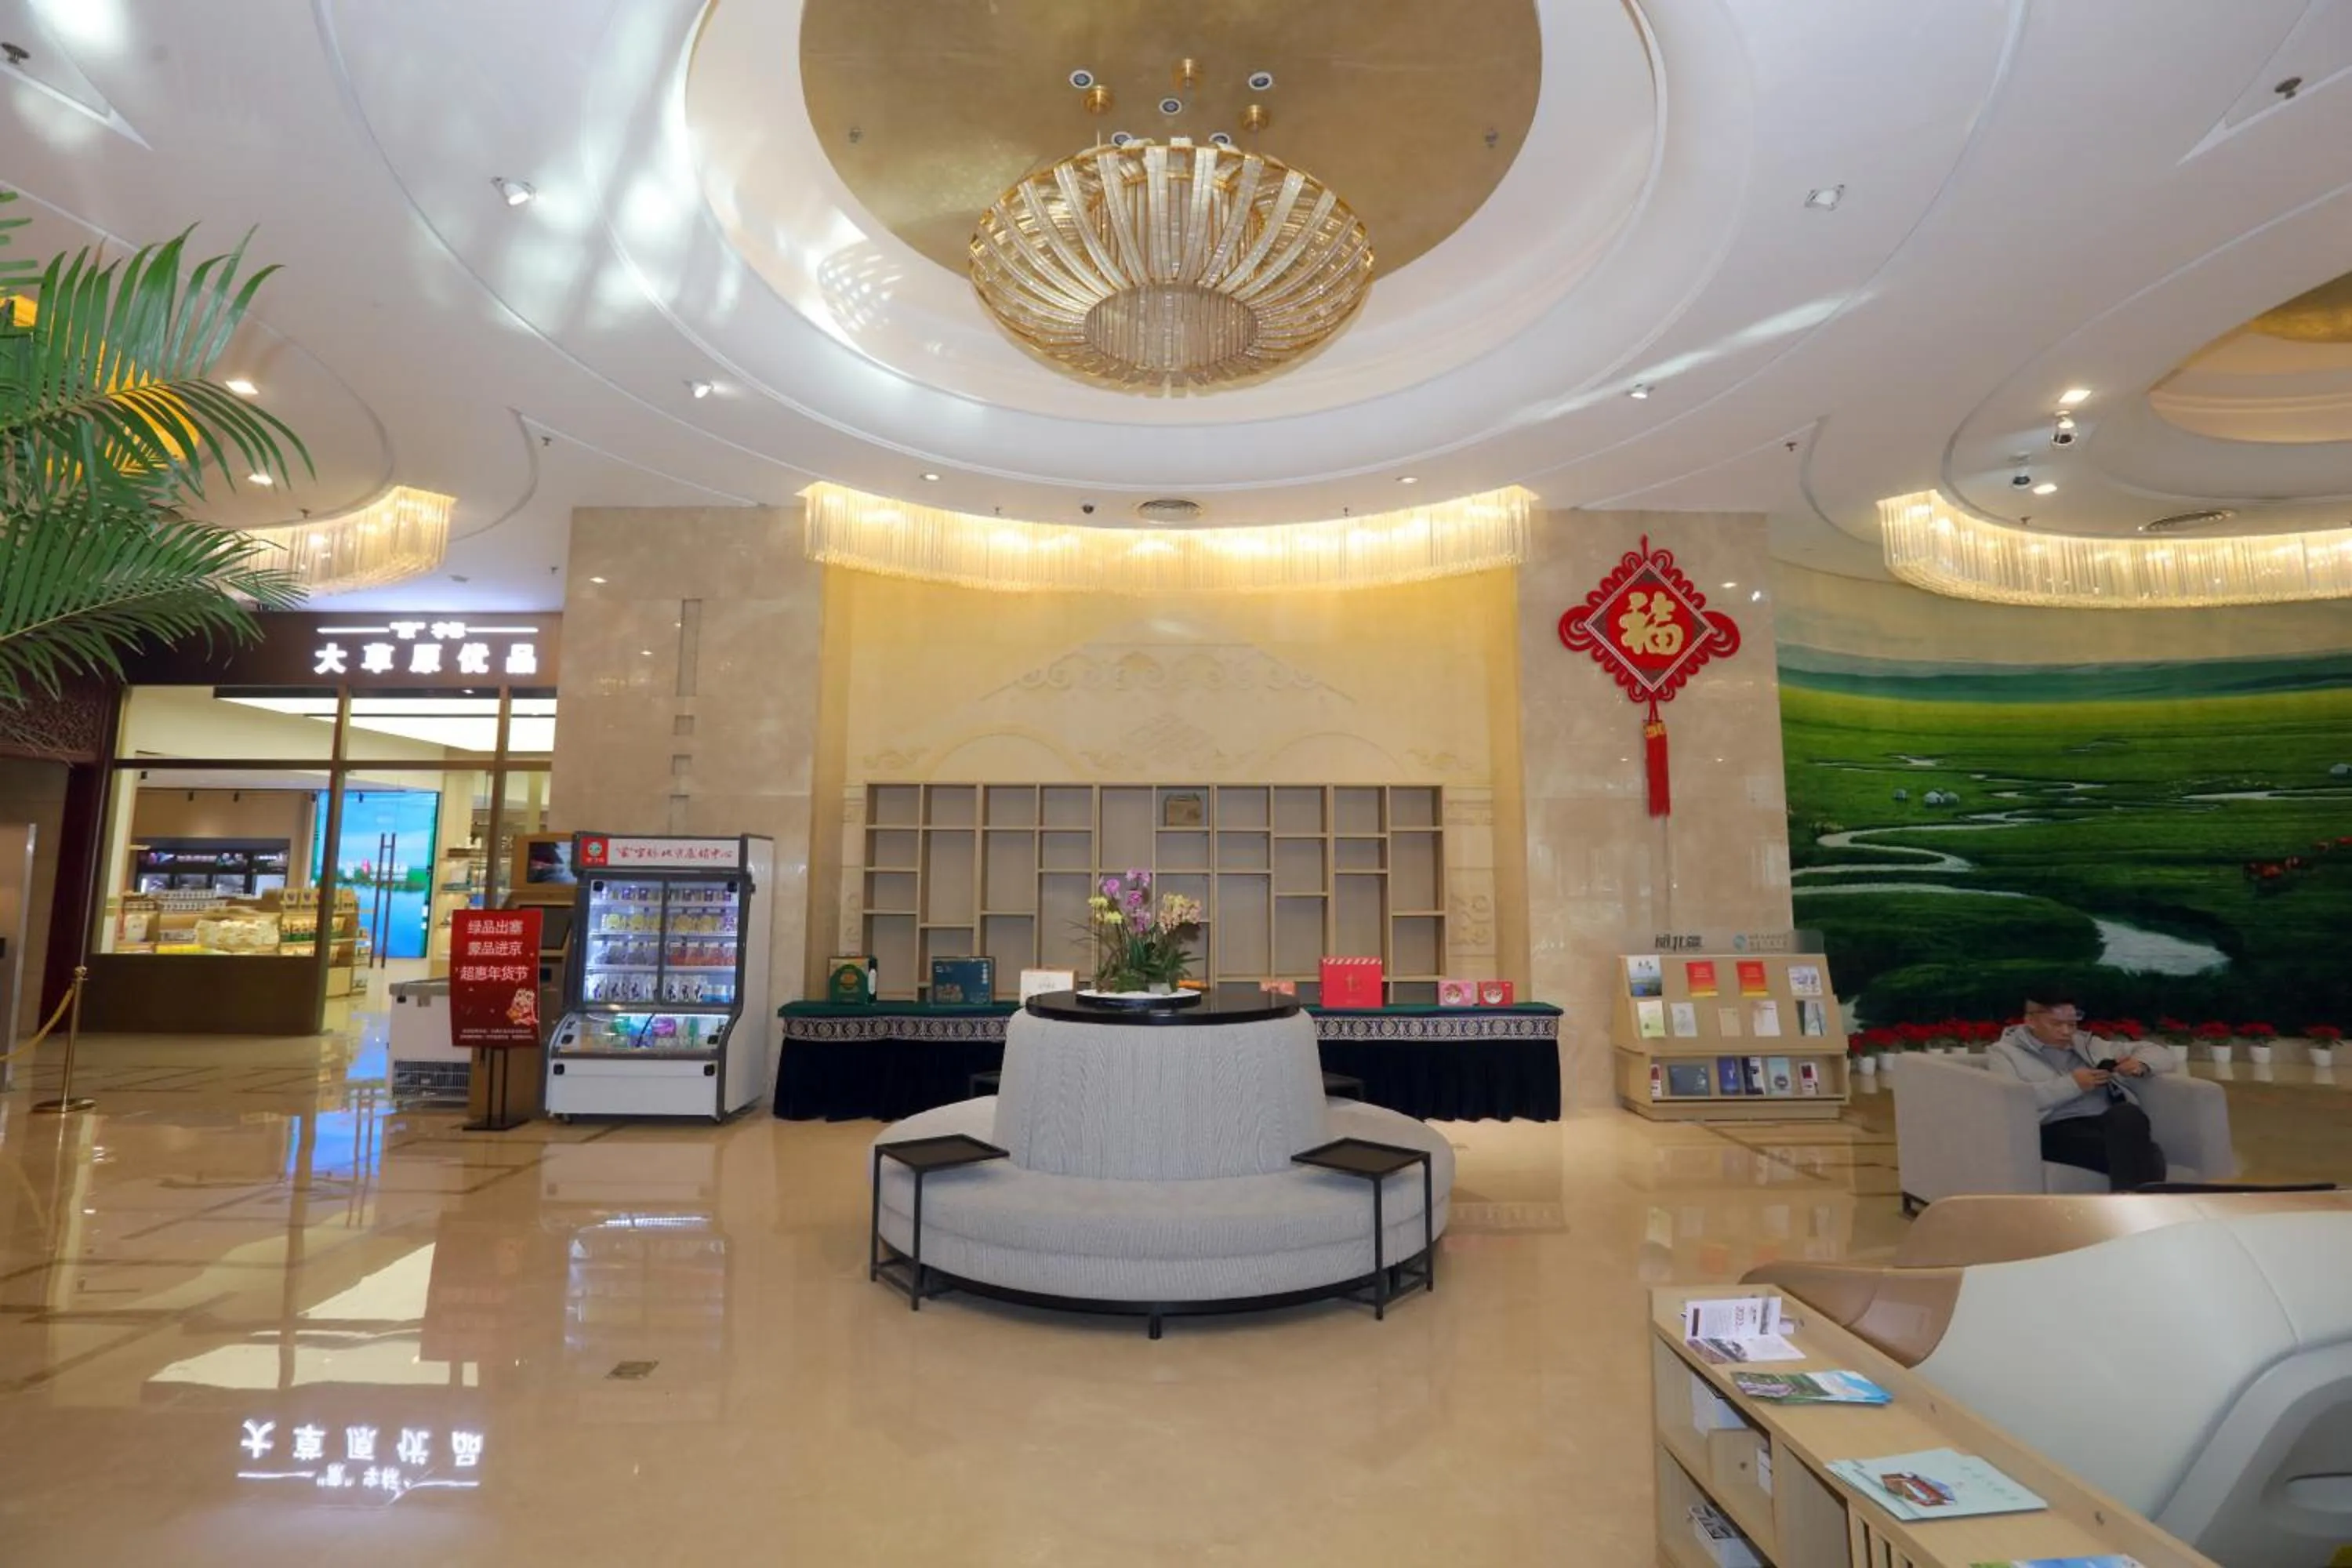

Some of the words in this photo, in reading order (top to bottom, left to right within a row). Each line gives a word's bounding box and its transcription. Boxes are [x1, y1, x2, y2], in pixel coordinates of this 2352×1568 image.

[1619, 590, 1684, 655] 福
[459, 965, 530, 982] 超惠年货节
